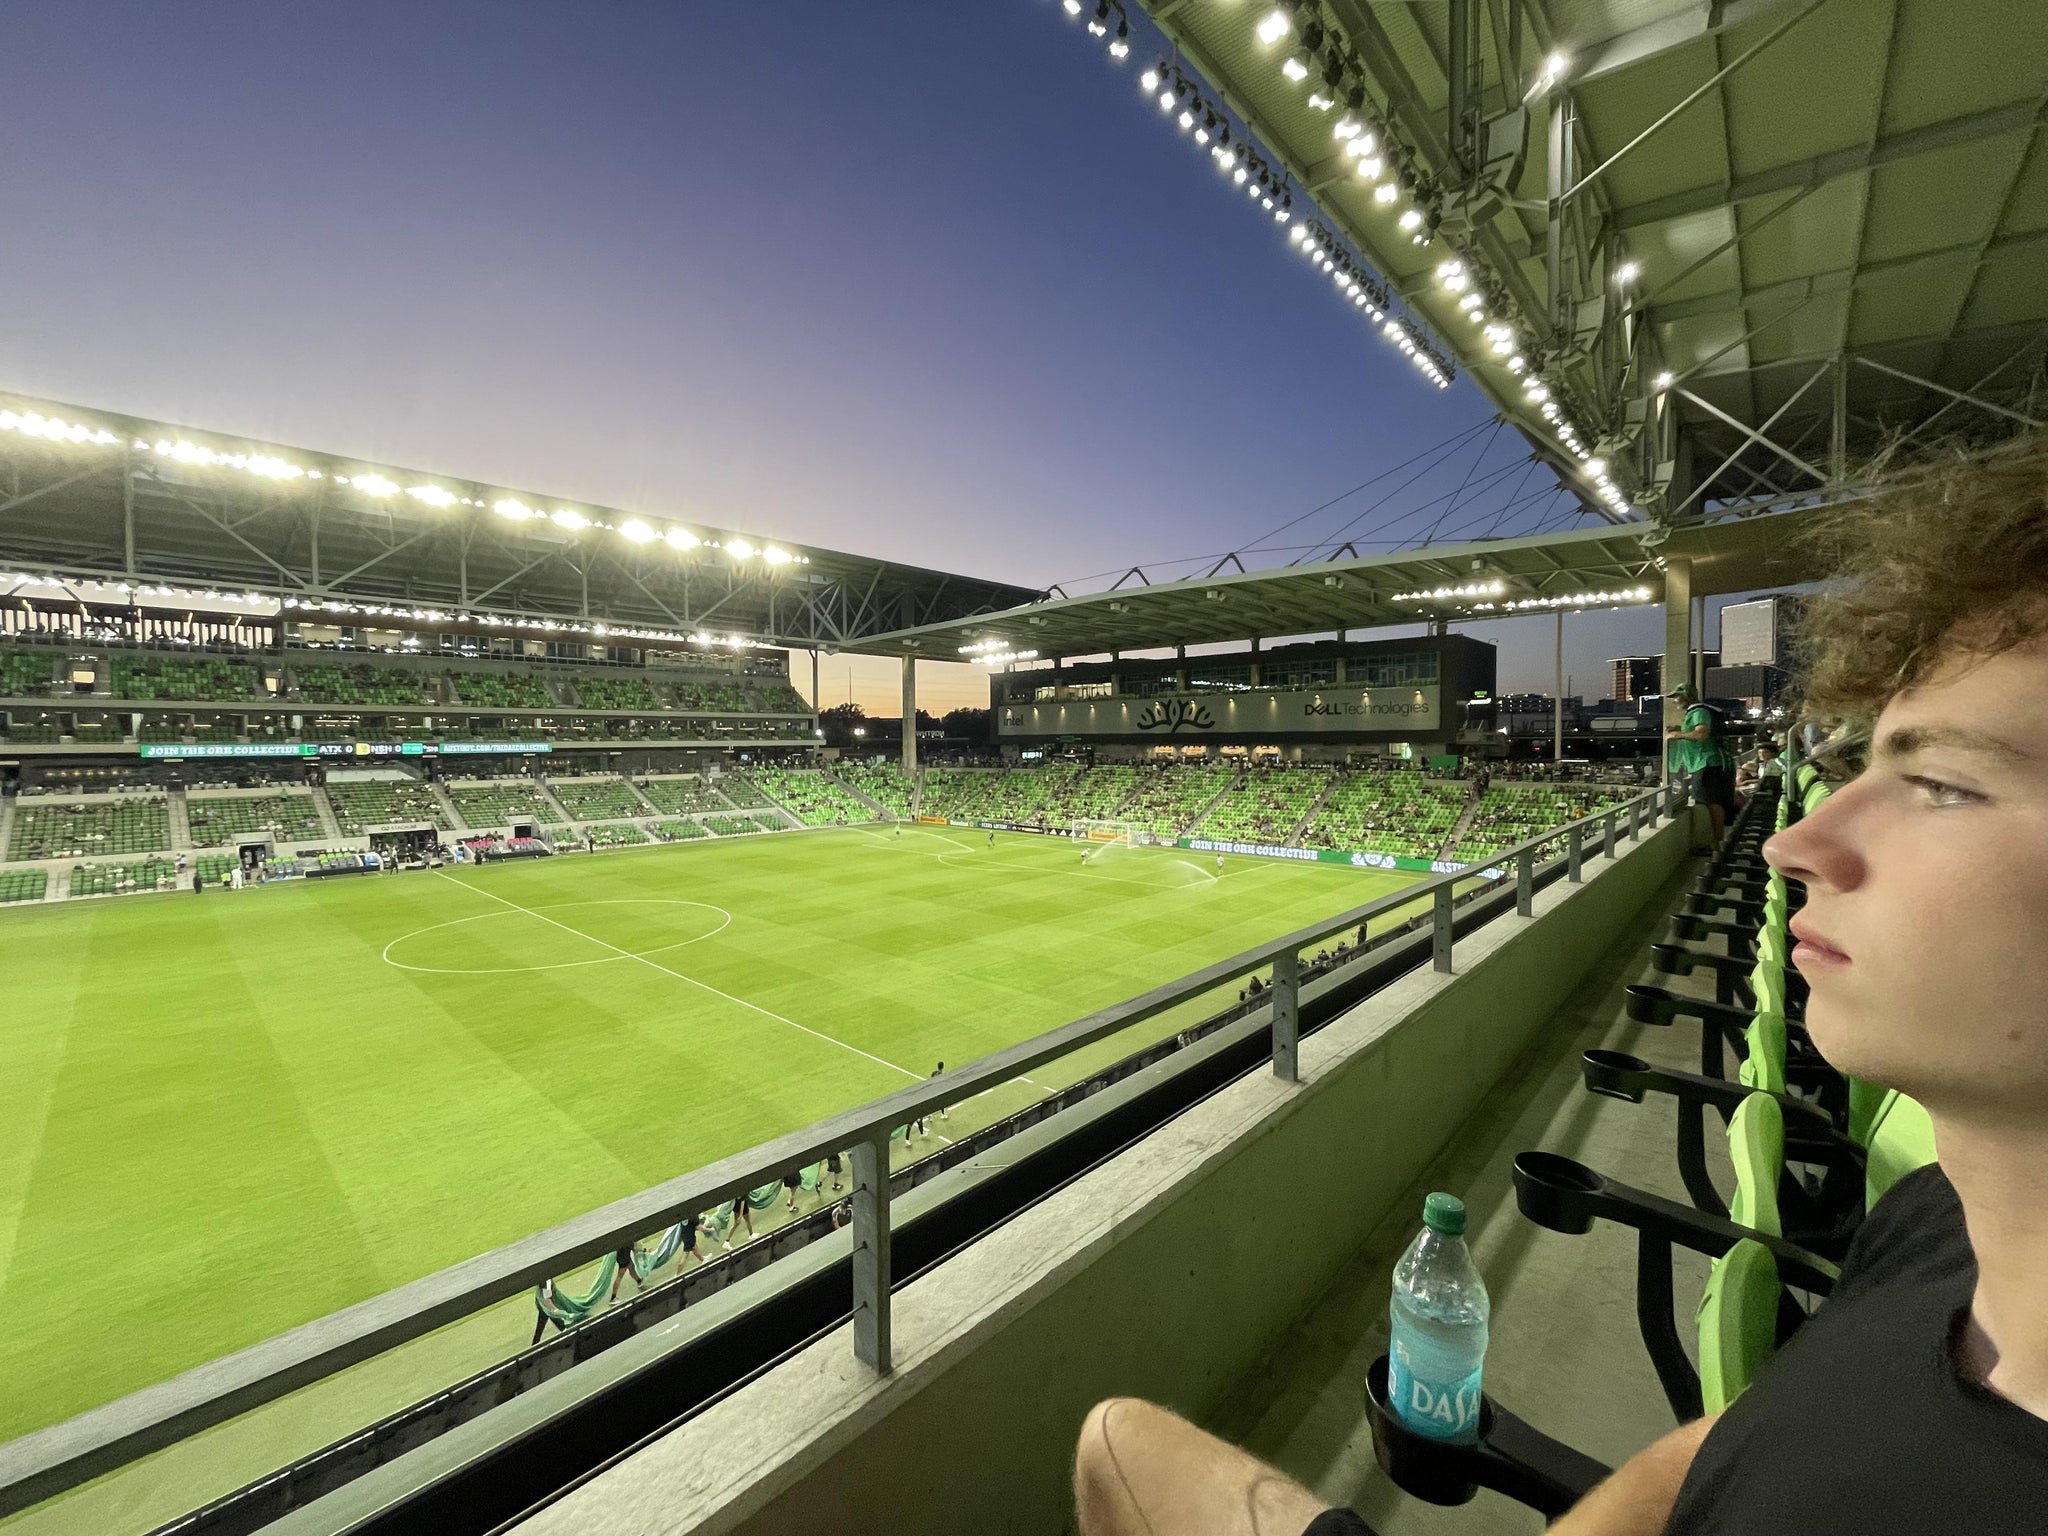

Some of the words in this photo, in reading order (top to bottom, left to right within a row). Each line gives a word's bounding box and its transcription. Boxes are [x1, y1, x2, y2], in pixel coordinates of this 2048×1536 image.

[1304, 703, 1341, 716] DELL
[1341, 701, 1430, 717] Technologies
[1003, 714, 1024, 726] intel
[148, 747, 179, 755] JOIN
[181, 747, 205, 755] THE
[234, 746, 299, 754] COLLECTIVE
[319, 745, 341, 753] ATX
[371, 745, 392, 753] NSH
[1189, 840, 1212, 850] JOIN
[1213, 842, 1232, 852] THE
[1256, 845, 1318, 860] COLLECTIVE
